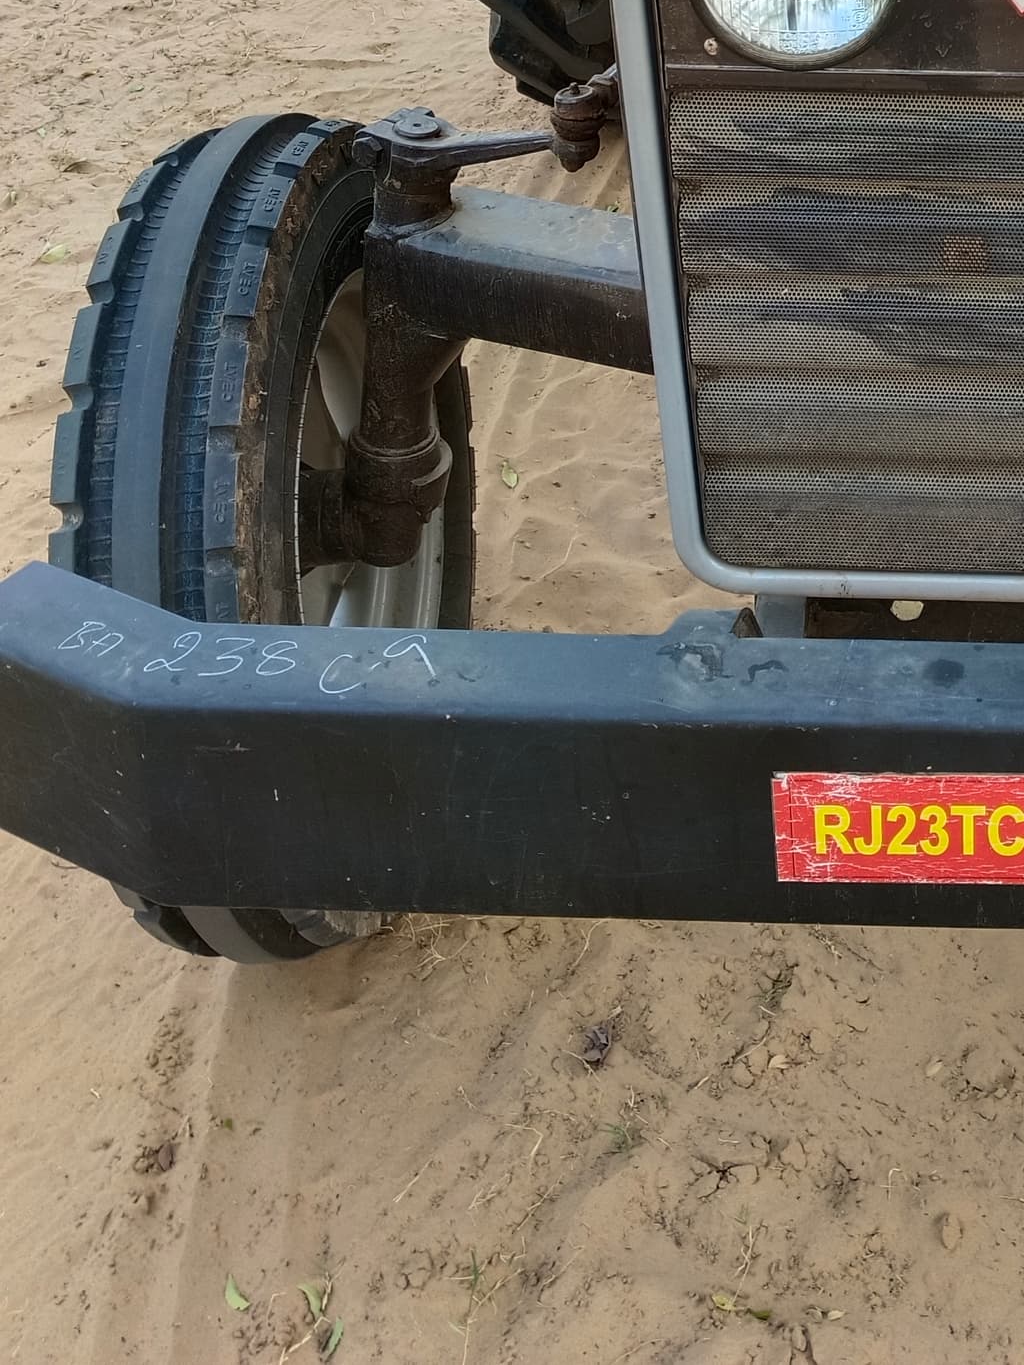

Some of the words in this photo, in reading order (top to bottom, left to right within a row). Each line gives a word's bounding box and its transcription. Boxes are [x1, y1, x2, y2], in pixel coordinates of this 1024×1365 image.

[263, 187, 281, 212] CEAT
[238, 262, 257, 296] CEAT
[221, 361, 238, 402] CEAT
[213, 481, 230, 523] CEAT
[143, 631, 298, 676] 238
